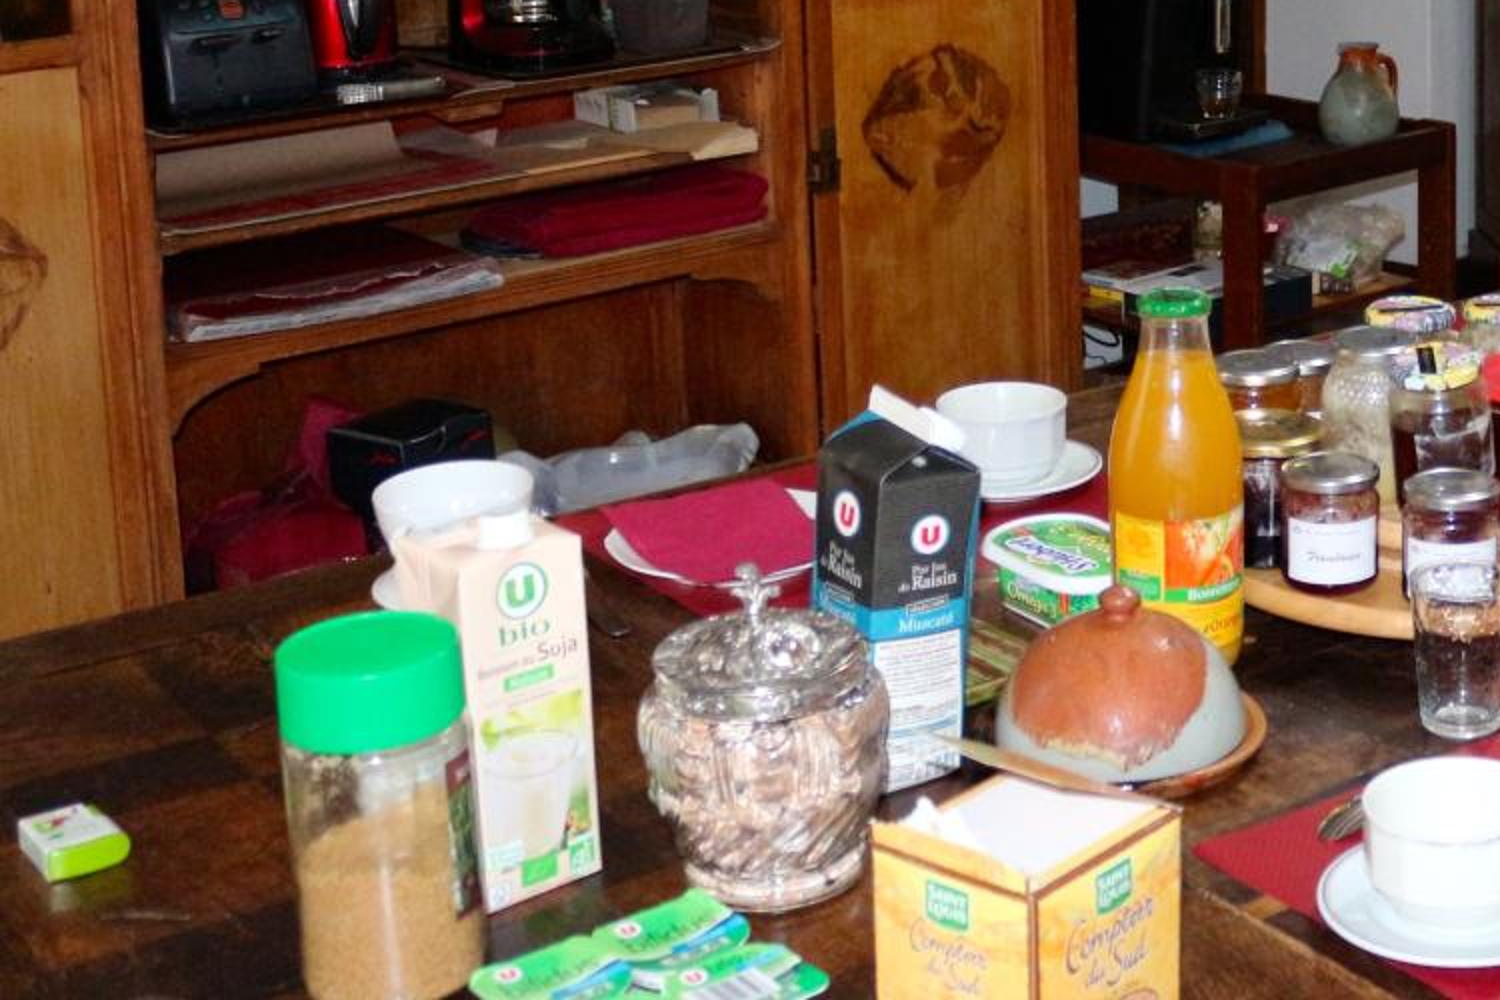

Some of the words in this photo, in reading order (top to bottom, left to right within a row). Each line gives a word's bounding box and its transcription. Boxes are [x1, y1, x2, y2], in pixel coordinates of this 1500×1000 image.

[839, 501, 855, 528] U
[920, 525, 941, 547] U
[505, 572, 535, 609] U
[911, 571, 958, 591] Raisin
[498, 619, 552, 648] bio
[537, 634, 578, 661] Soja
